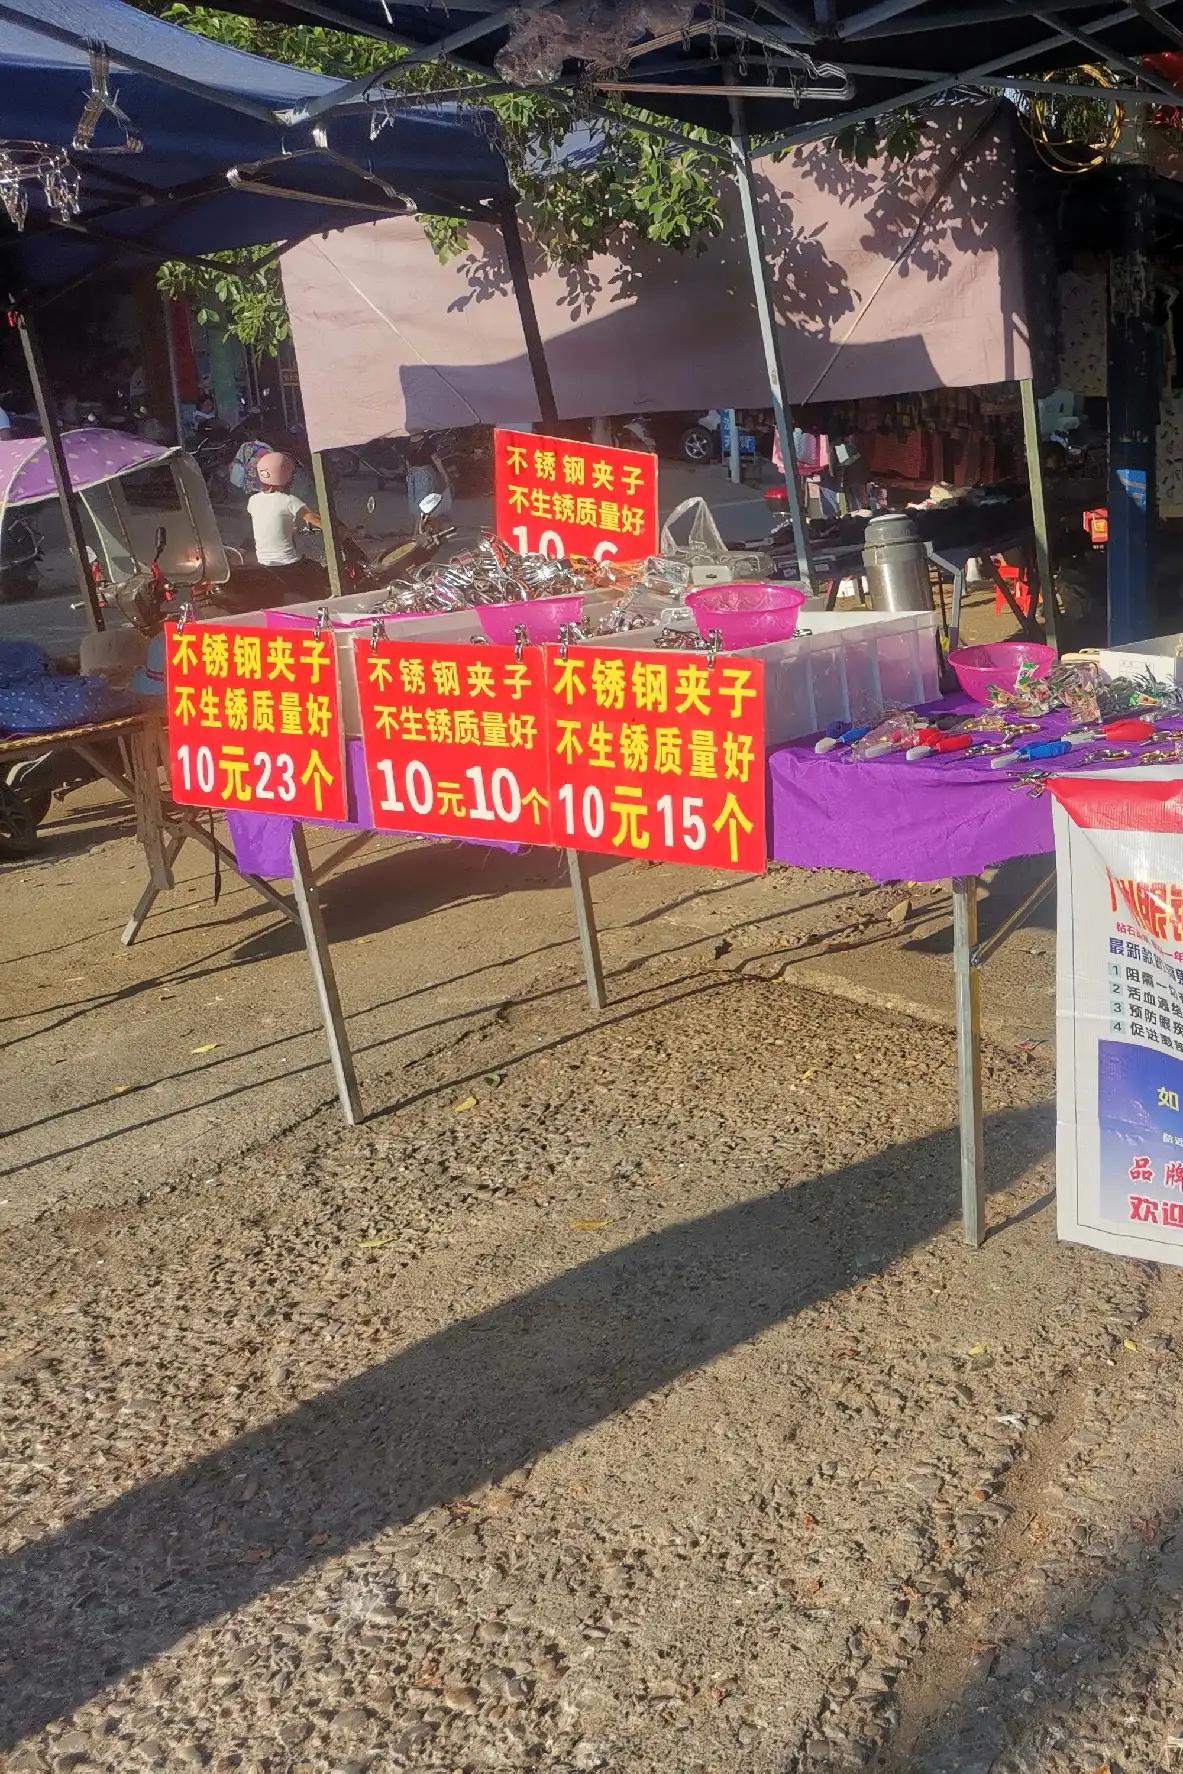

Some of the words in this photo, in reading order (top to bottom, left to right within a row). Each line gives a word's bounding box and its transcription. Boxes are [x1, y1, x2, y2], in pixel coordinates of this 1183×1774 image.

[506, 446, 644, 495] 不锈钢夹子
[508, 485, 645, 536] 不生锈质量好
[172, 632, 330, 684] 不锈钢夹子
[369, 657, 532, 700] 不锈钢夹子
[175, 687, 332, 736] 不生锈质量好
[553, 657, 757, 718] 不锈钢夹子
[374, 705, 537, 750] 不生锈质量好
[556, 720, 754, 783] 不生锈质量好
[177, 743, 333, 811] 10元23个
[376, 758, 549, 825] 10元10个
[558, 783, 753, 862] 10元15个
[1126, 985, 1183, 1019] 活血通络
